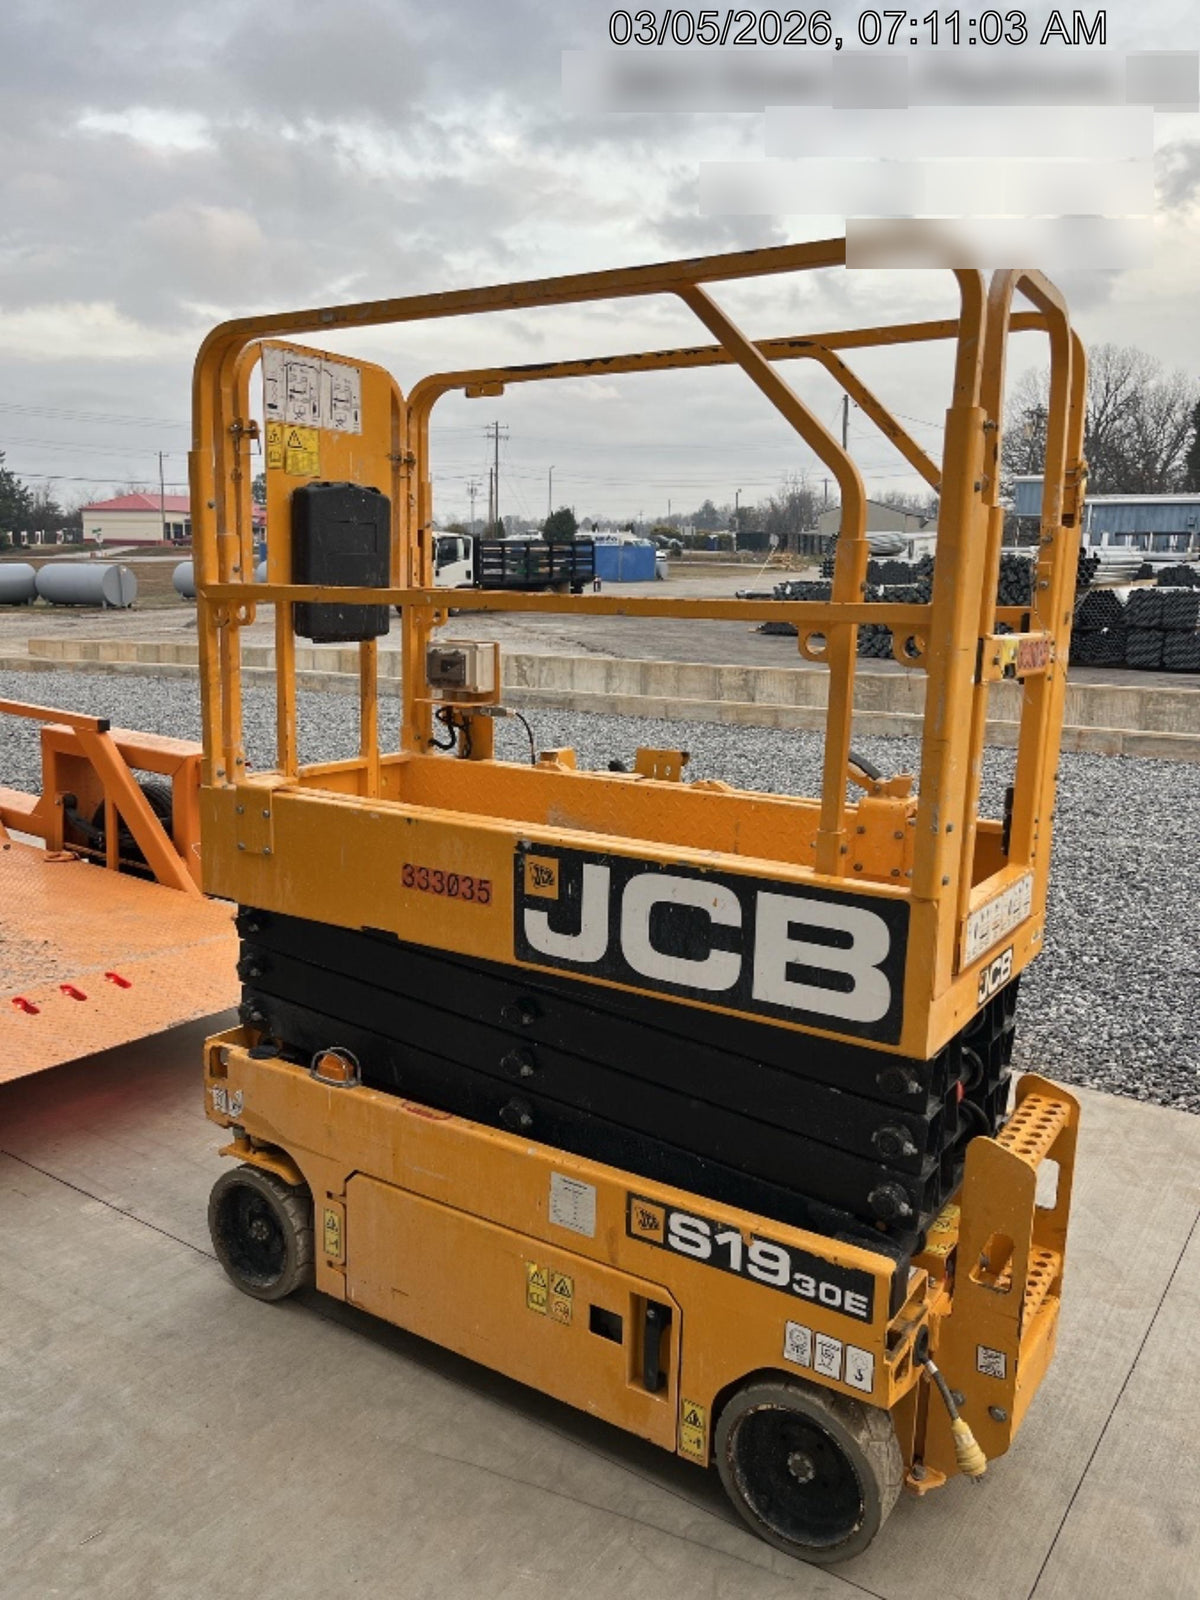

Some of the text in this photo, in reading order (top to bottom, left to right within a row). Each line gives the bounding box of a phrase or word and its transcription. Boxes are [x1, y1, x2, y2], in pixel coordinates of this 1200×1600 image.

[402, 863, 490, 904] 333035
[523, 863, 893, 1023] JCB
[978, 949, 1013, 1004] JCB
